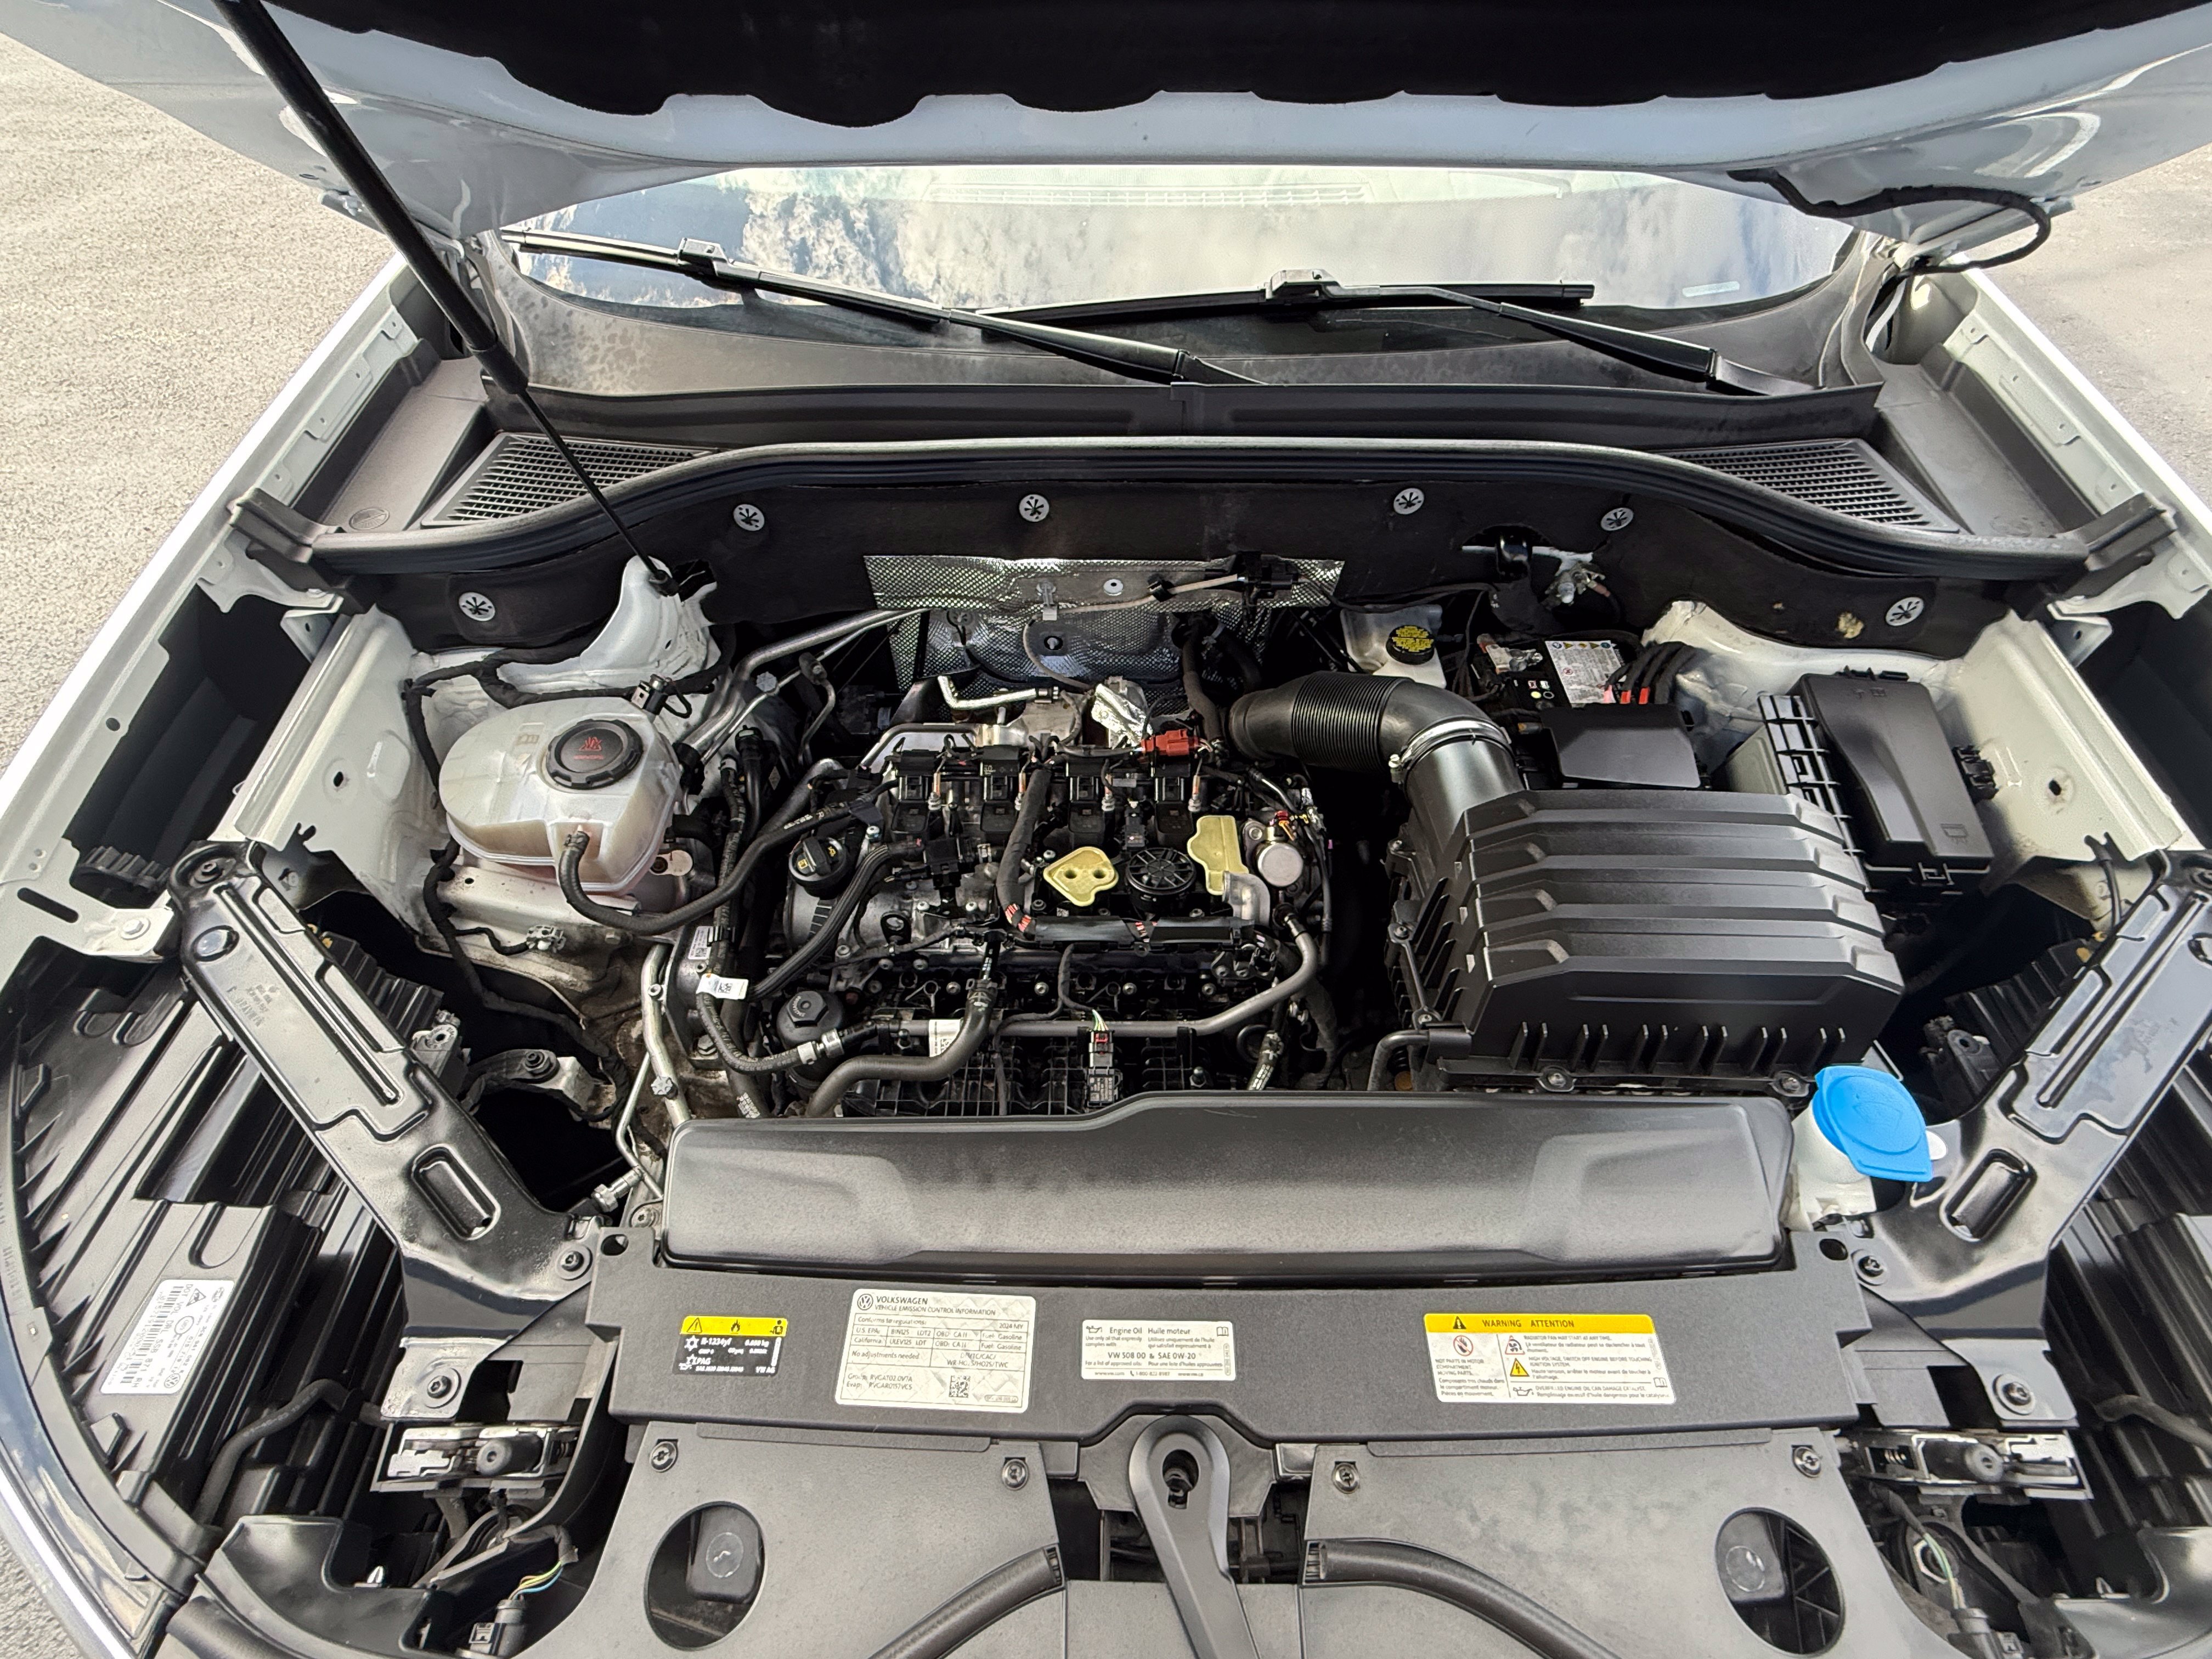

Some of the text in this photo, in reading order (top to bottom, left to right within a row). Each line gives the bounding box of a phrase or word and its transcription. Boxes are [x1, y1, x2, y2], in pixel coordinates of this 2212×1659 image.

[182, 1284, 193, 1296] DOT
[877, 1296, 928, 1305] VOLKSWAGEN
[170, 1301, 182, 1314] VOL
[1482, 1319, 1522, 1328] WARNING
[1110, 1327, 1131, 1335] Engine
